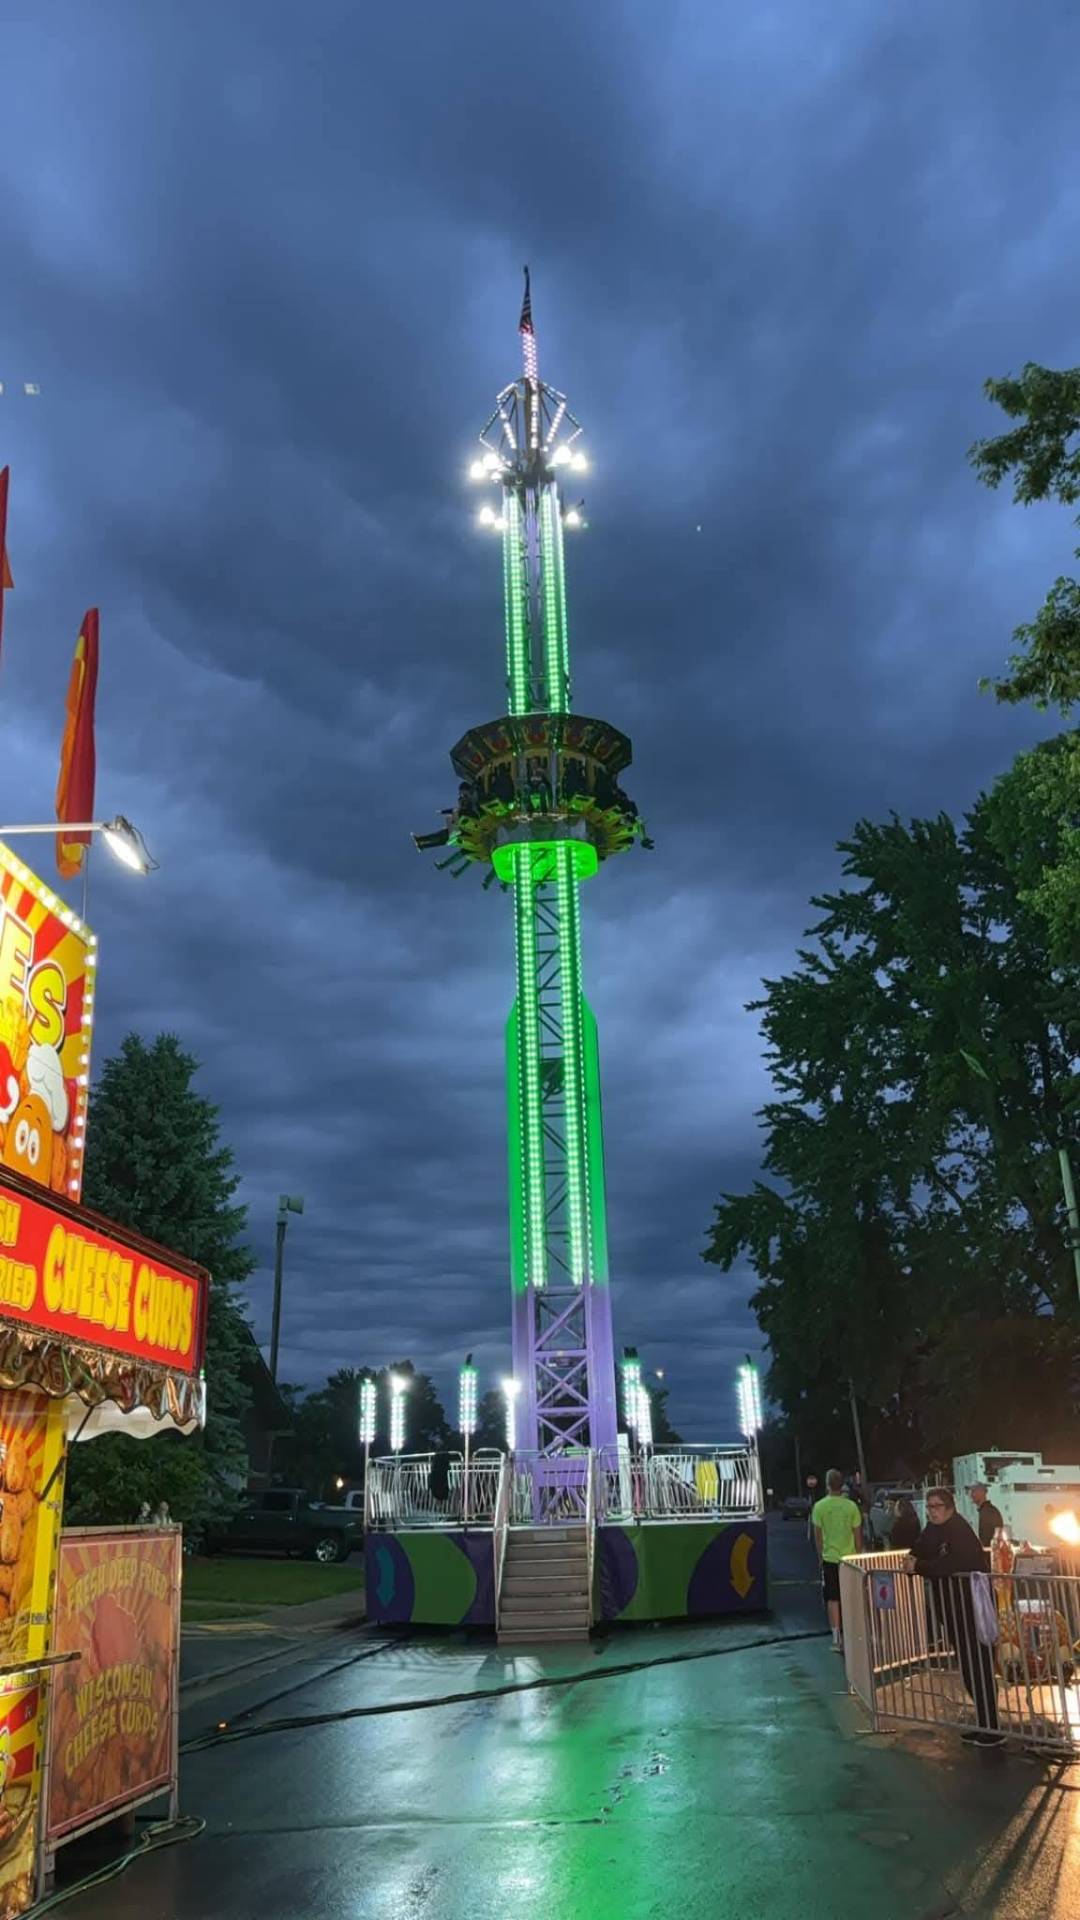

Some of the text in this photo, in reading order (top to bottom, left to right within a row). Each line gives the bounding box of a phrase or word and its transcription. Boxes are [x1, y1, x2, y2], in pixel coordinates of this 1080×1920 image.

[43, 1223, 194, 1355] CHEESE CURDS
[68, 1557, 168, 1620] FRESH DEEP FRIED
[76, 1663, 153, 1720] WISCONSIN
[64, 1703, 117, 1778] CHEESE
[120, 1701, 158, 1742] CURDS
